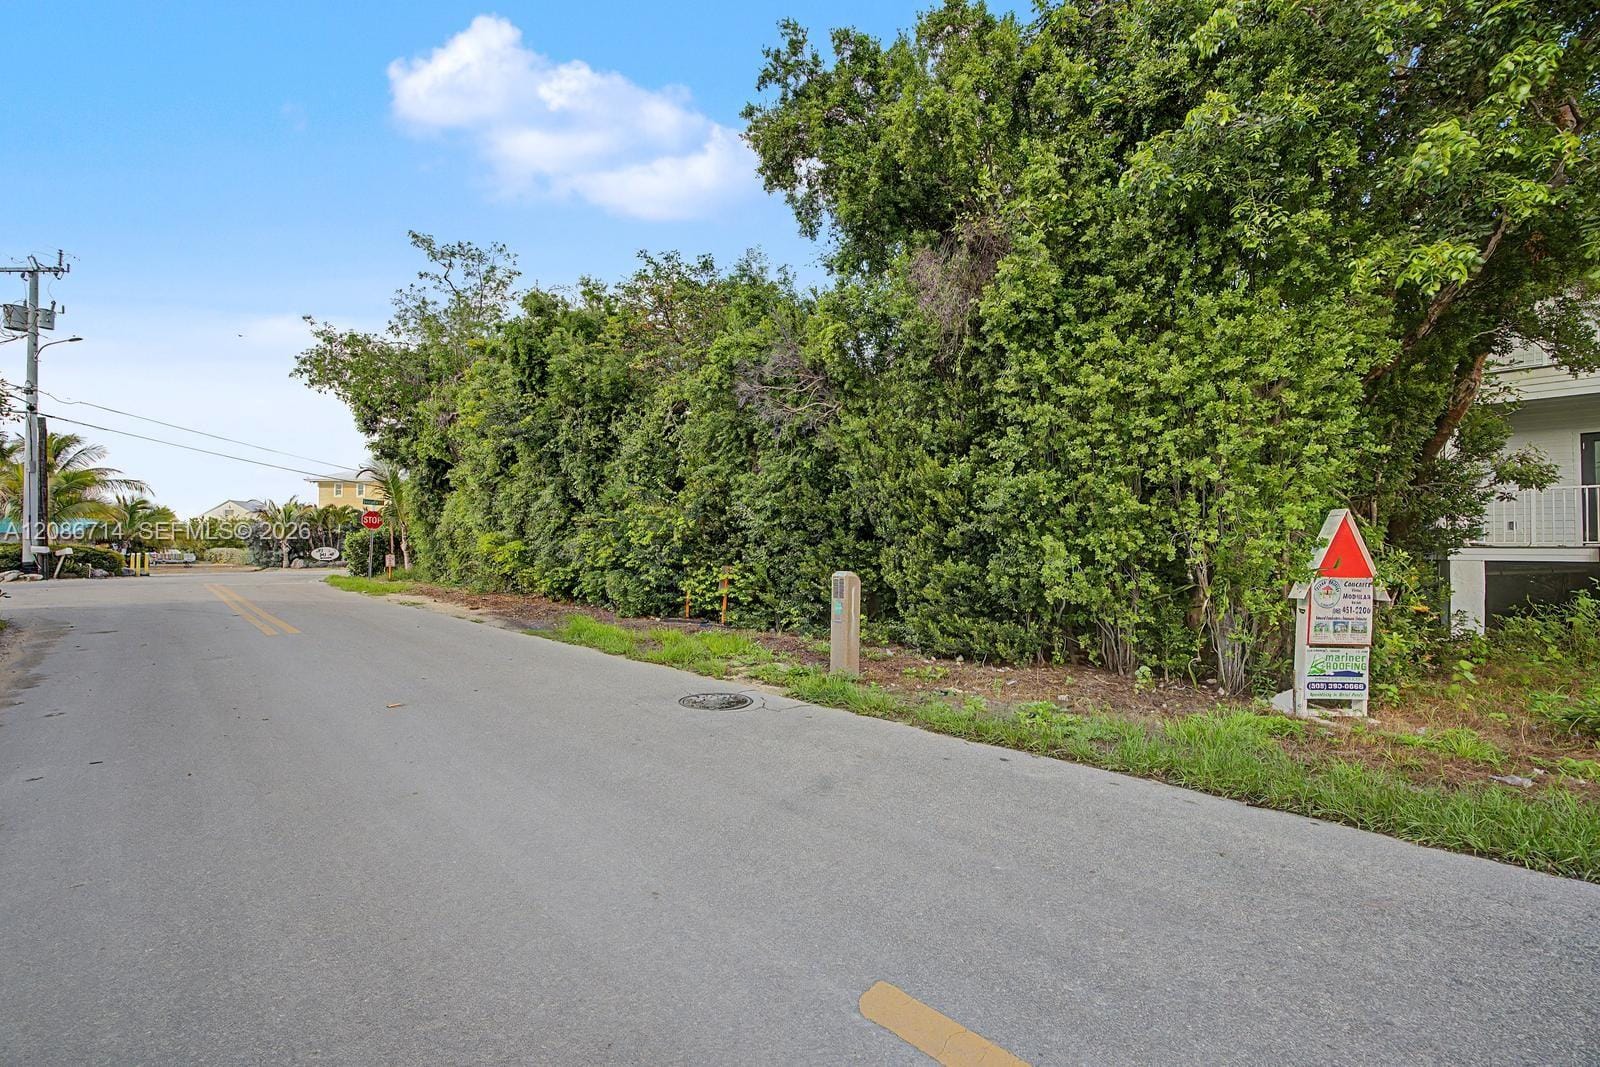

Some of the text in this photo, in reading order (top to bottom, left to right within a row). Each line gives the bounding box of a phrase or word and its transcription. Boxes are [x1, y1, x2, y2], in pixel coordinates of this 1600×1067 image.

[363, 516, 382, 524] STOP
[1325, 652, 1367, 662] mariner
[1325, 662, 1367, 670] ROOFING
